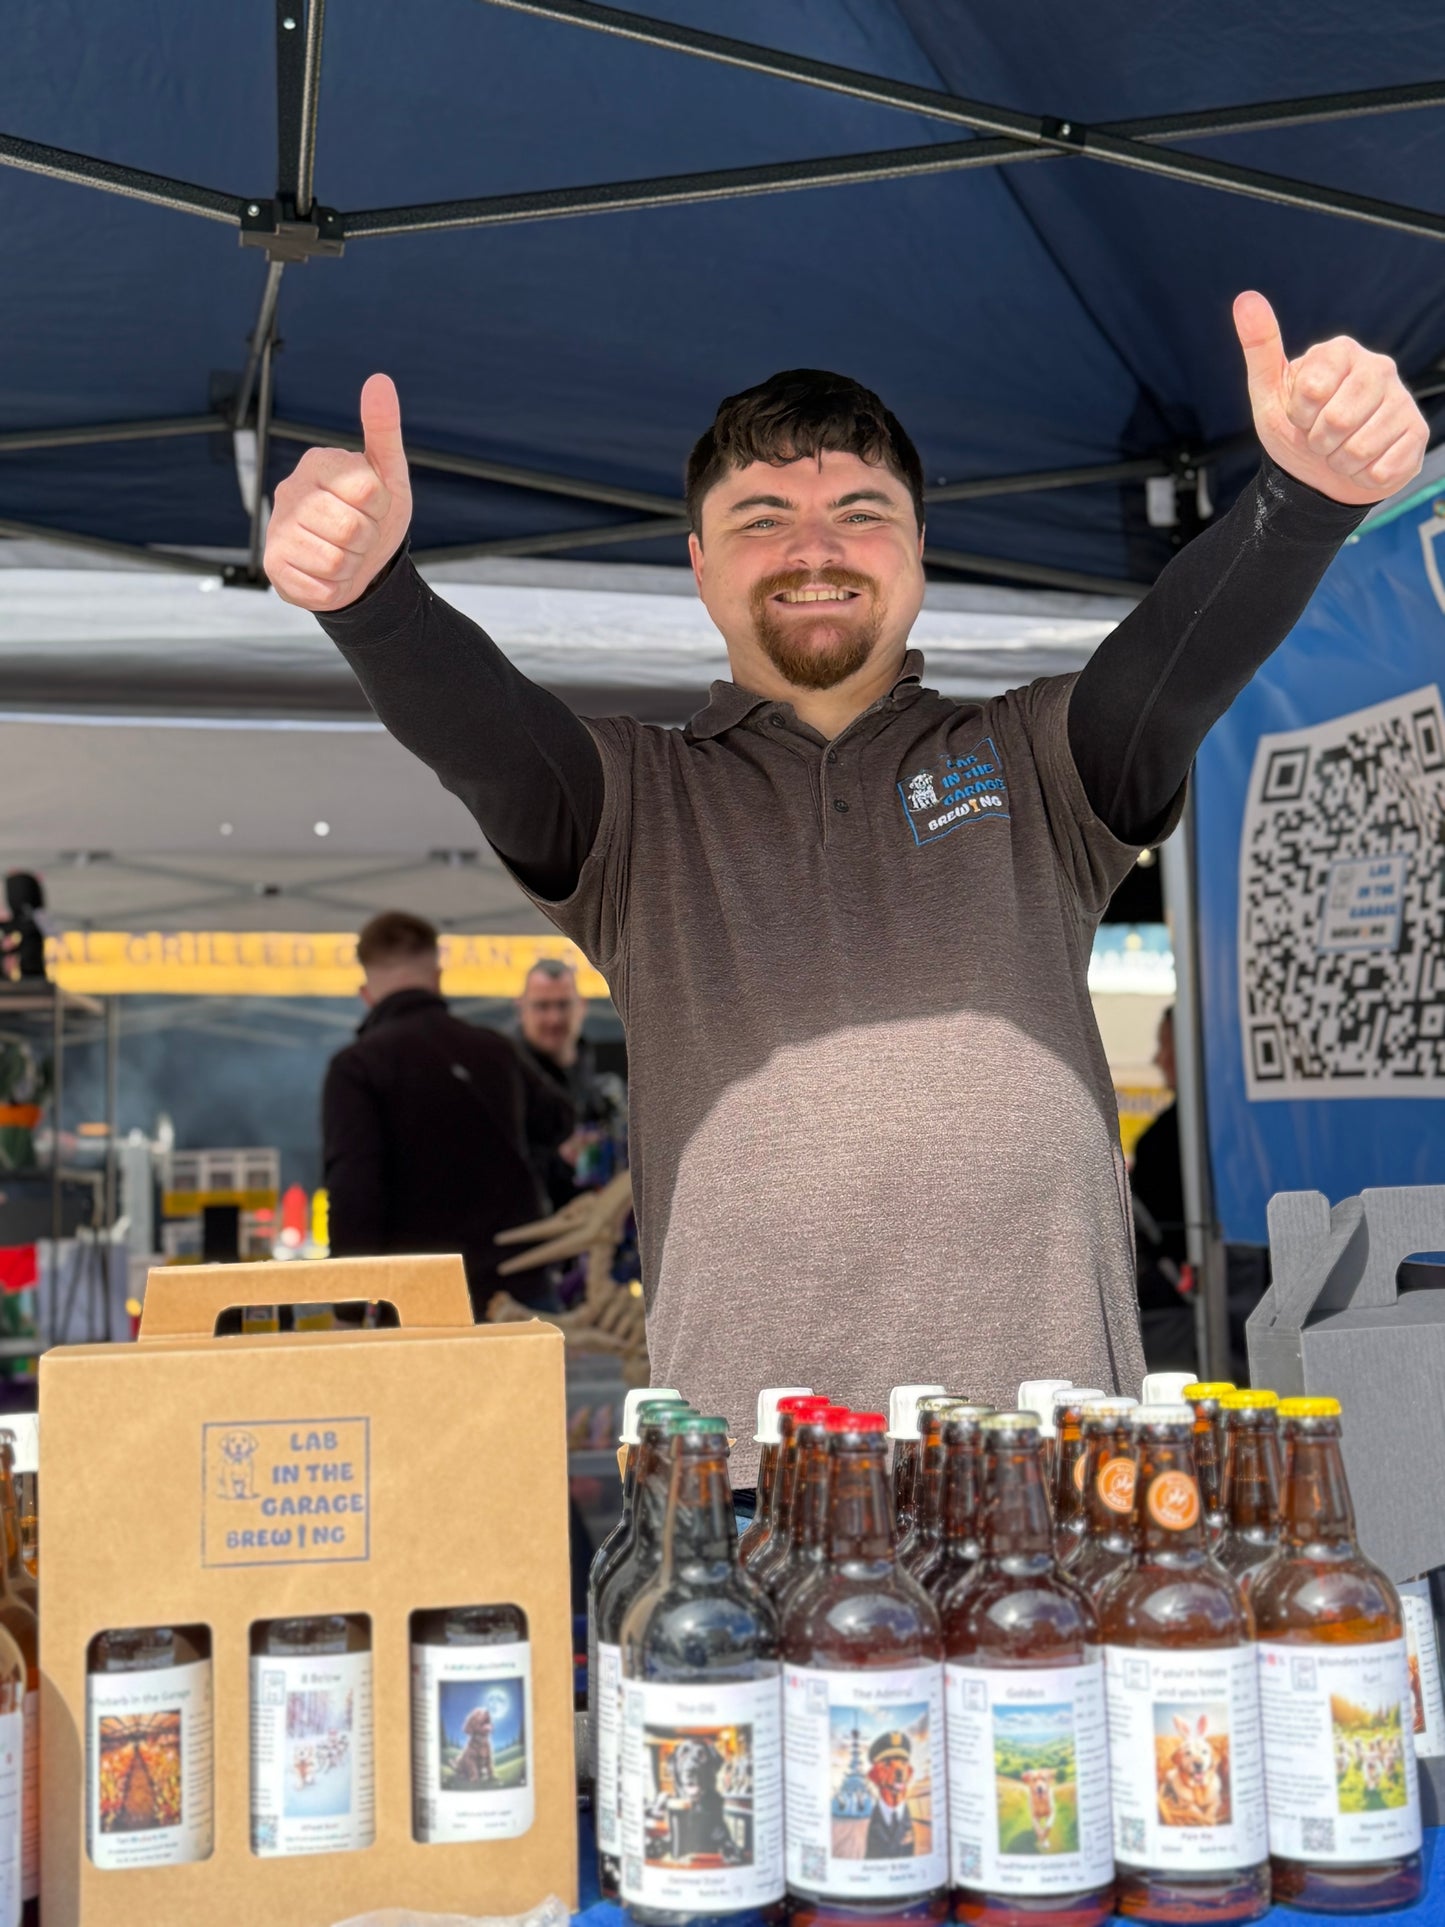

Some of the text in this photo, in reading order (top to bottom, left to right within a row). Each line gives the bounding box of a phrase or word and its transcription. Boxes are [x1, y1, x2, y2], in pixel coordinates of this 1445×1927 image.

[942, 763, 996, 789] IN THE
[943, 778, 1006, 807] GARAGE
[928, 795, 1003, 831] BREWING
[290, 1431, 338, 1452] LAB
[272, 1462, 354, 1485] IN THE
[261, 1494, 364, 1517] GARAGE
[226, 1523, 345, 1549] BREWING
